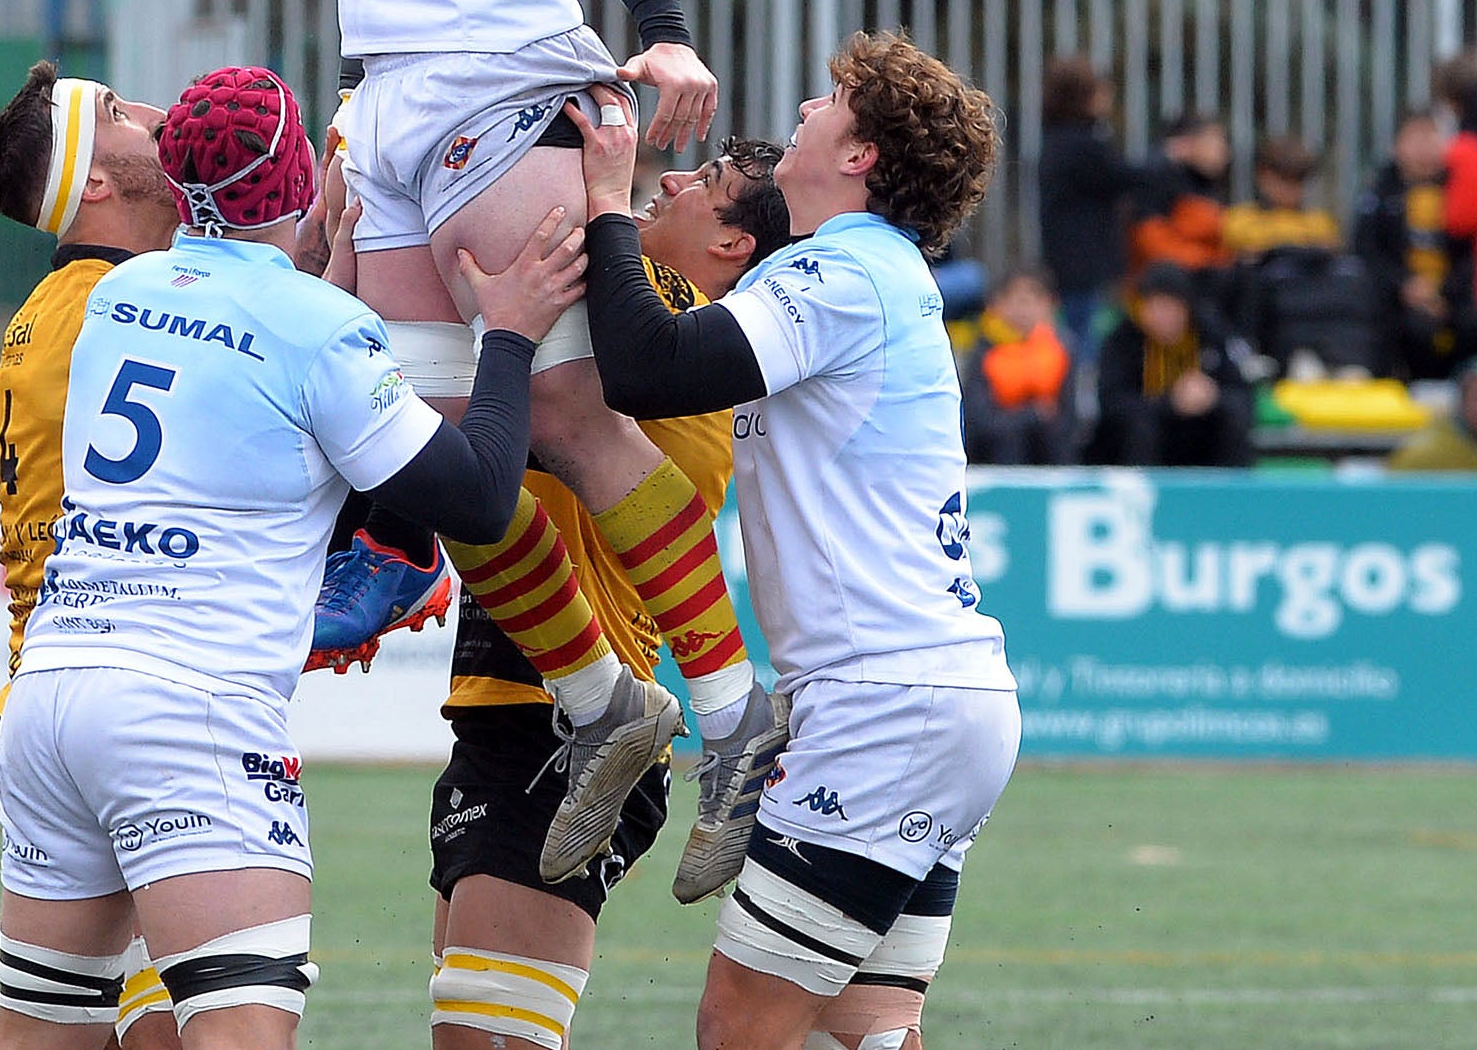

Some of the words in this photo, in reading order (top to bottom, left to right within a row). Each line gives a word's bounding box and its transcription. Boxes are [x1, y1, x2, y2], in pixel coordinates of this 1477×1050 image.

[111, 302, 266, 362] SUMAL
[82, 358, 177, 485] 5
[1046, 493, 1463, 639] Burgos
[145, 811, 212, 835] Youin
